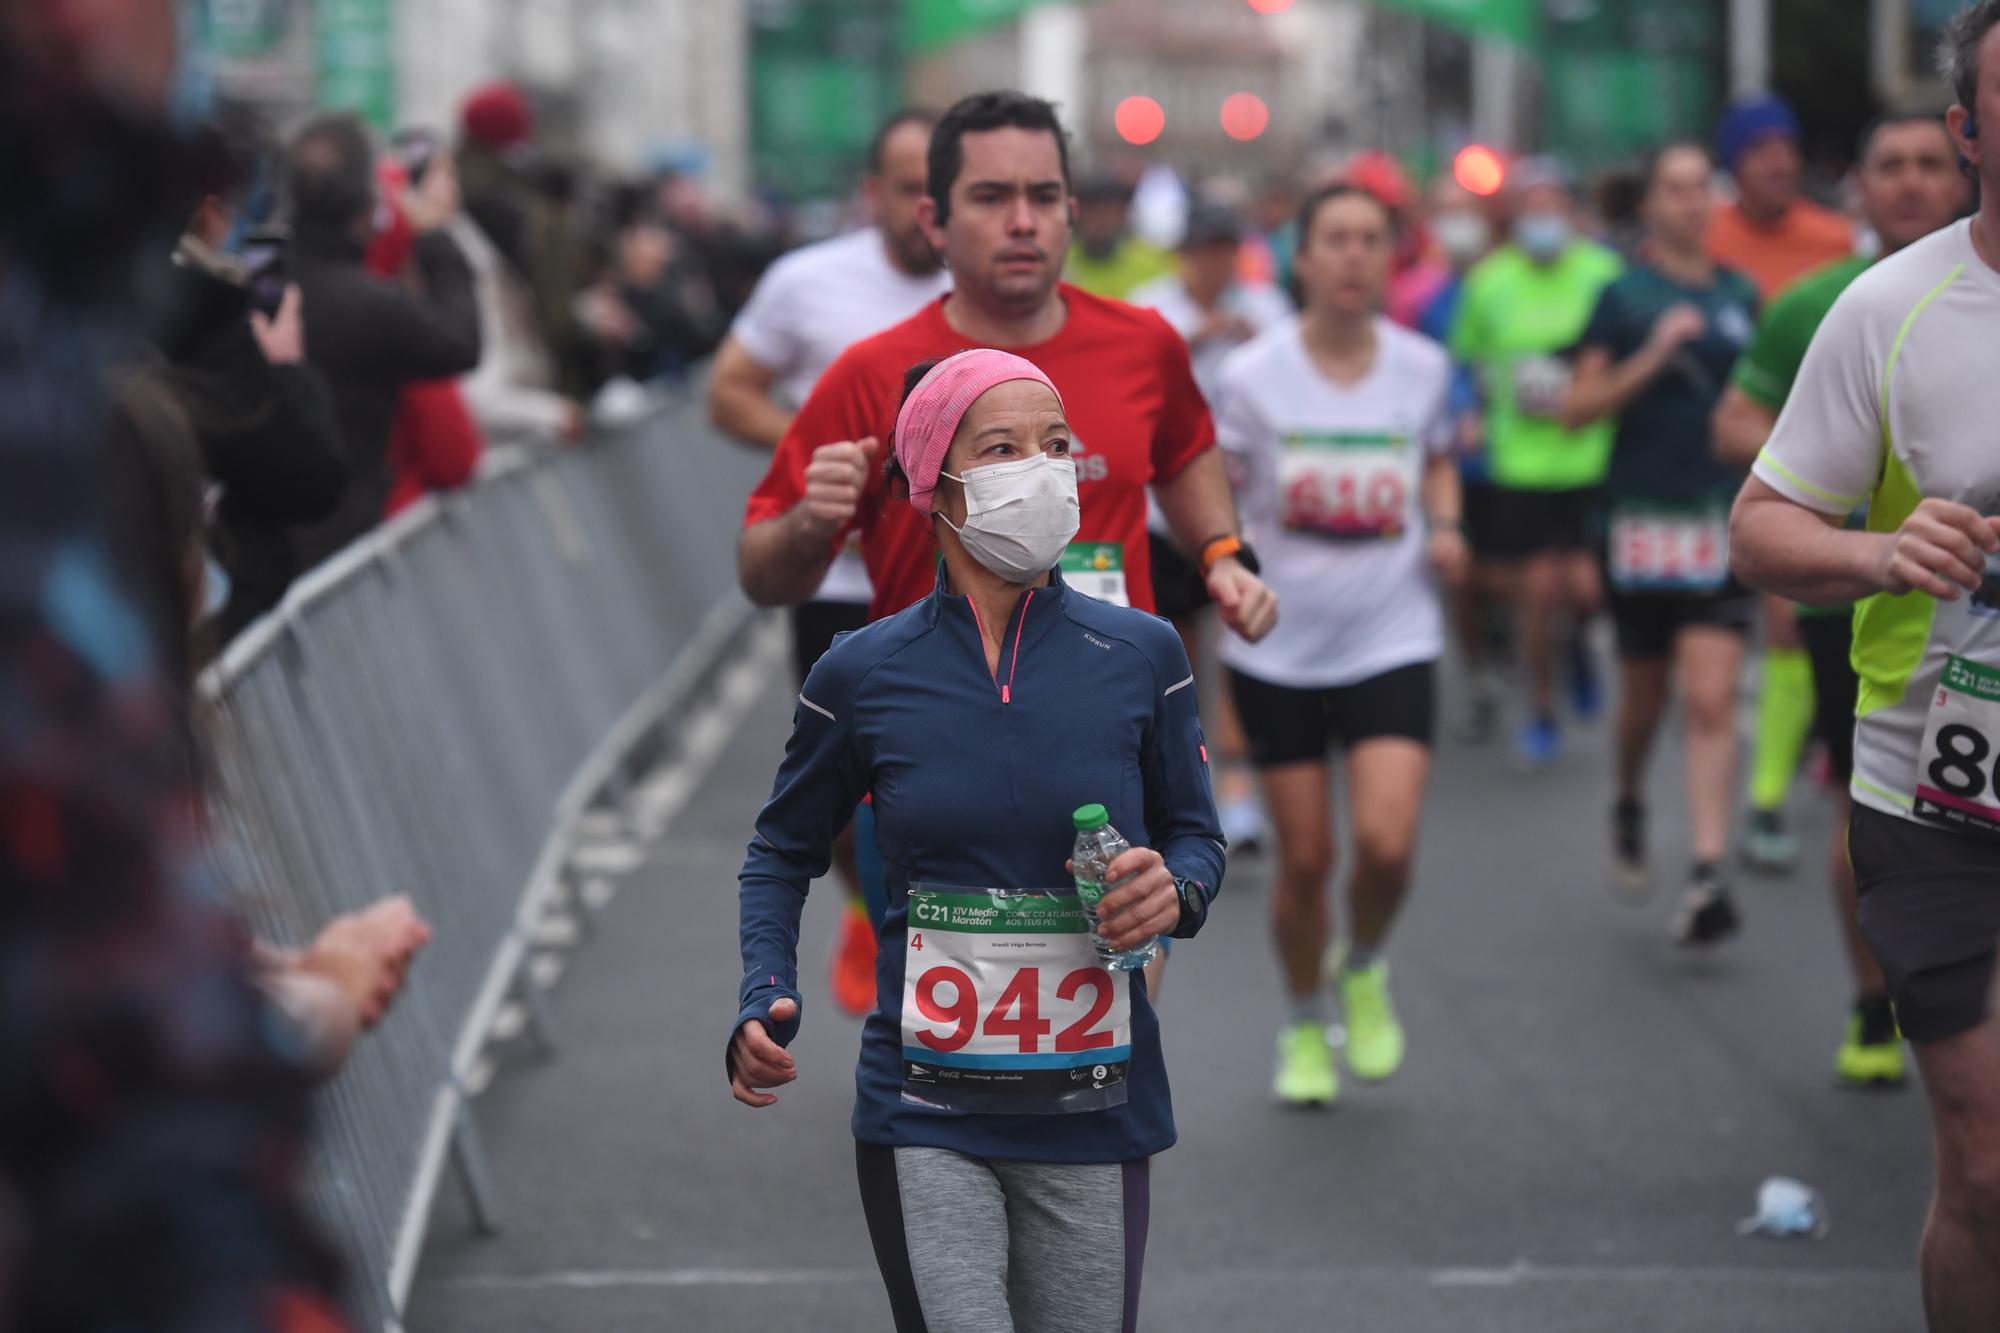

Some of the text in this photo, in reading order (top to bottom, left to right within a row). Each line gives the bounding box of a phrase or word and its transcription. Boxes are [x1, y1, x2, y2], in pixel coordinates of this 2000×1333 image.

[1936, 690, 1948, 706] 3
[1928, 723, 2000, 804] 8
[952, 906, 999, 917] XIV Media
[1032, 910, 1046, 918] CO
[1046, 909, 1083, 919] ATLÁNTIC
[952, 915, 992, 926] Maratón
[1005, 918, 1022, 926] AOS
[1024, 918, 1042, 926] TEUS
[911, 933, 923, 951] 4
[914, 965, 1114, 1054] 942
